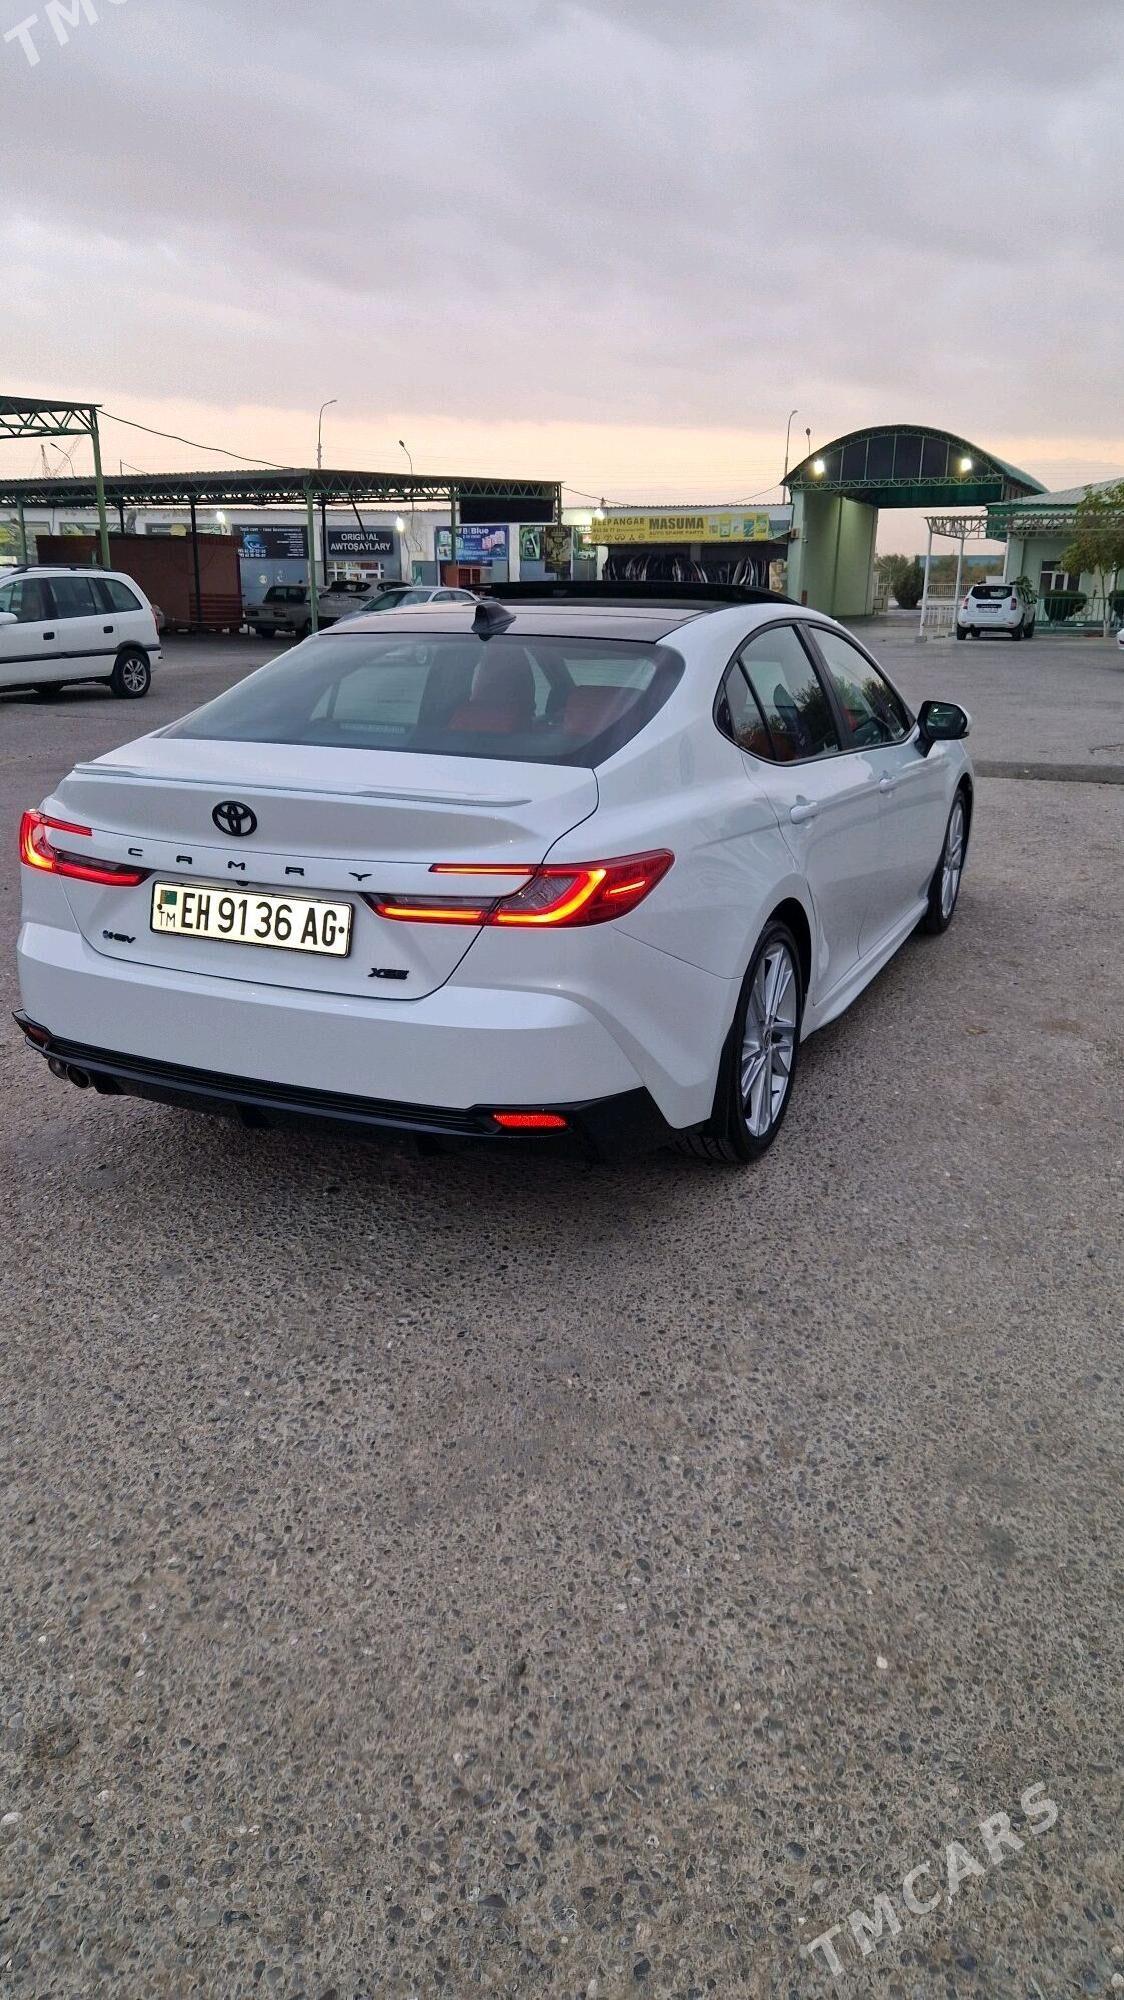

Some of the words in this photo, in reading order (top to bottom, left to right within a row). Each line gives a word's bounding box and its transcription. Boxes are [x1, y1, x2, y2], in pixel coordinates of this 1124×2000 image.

[613, 517, 645, 526] ANGAR
[649, 517, 704, 530] MASUMA
[470, 527, 490, 535] Blue
[127, 848, 373, 882] CAMRY
[158, 910, 176, 928] TM
[180, 892, 210, 931] EH
[217, 897, 293, 941] 9136
[300, 907, 336, 947] AG
